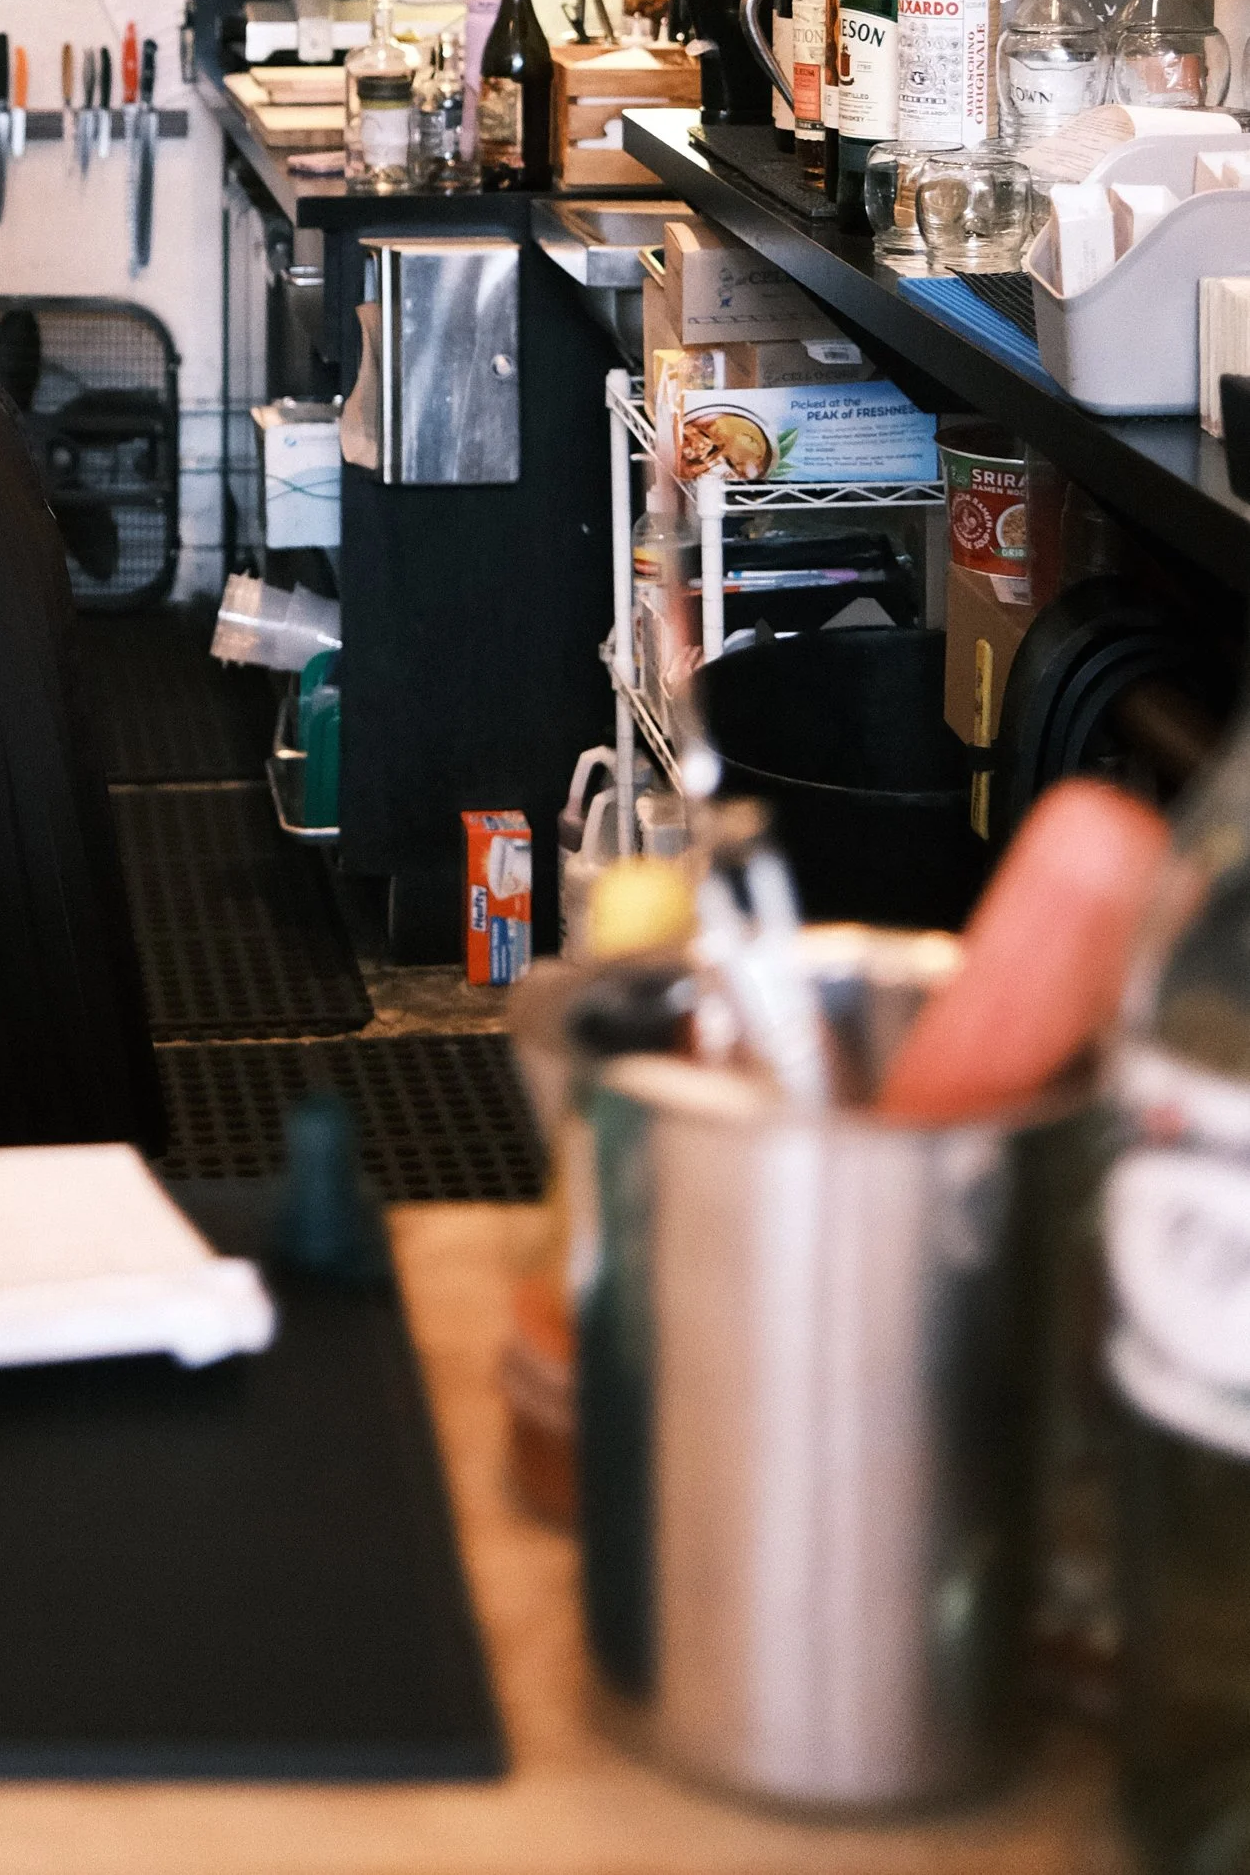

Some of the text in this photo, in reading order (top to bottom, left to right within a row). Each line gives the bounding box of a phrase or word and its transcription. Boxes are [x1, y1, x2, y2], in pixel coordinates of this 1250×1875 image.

[898, 0, 959, 16] UXARDO
[841, 18, 886, 48] ESON
[966, 31, 976, 117] MARASCHINO
[975, 23, 986, 125] ORIGINALE
[790, 398, 861, 410] Picked at the
[807, 410, 838, 421] PEAK
[841, 410, 853, 420] of
[972, 468, 1029, 487] SRIRA
[972, 483, 1004, 494] RAMEN
[474, 888, 487, 929] Hefty
